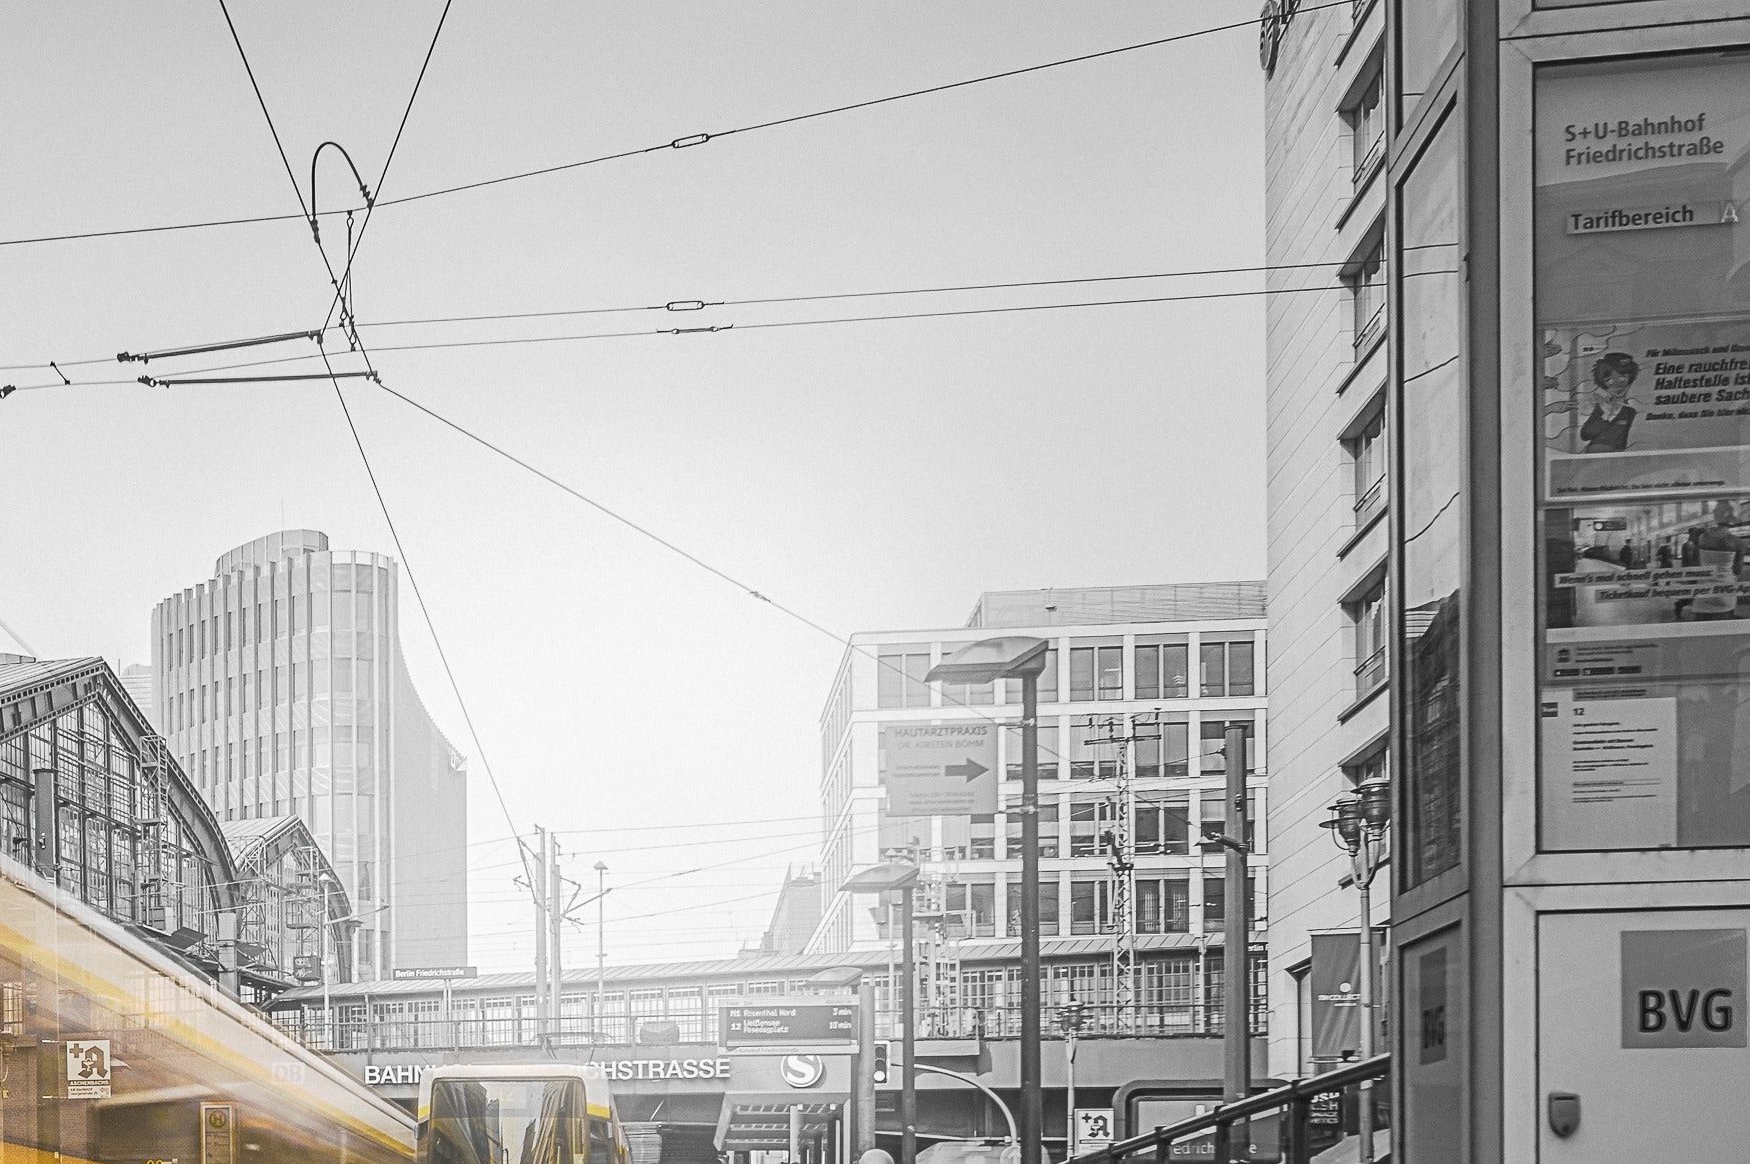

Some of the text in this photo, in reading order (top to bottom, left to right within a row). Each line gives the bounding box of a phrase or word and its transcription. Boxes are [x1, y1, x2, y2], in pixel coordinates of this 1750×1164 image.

[1564, 112, 1706, 143] S+U-Bahnhof
[1564, 136, 1725, 167] Friedrichstraße
[1571, 202, 1739, 231] Tarifbereich A
[1653, 362, 1685, 376] Eine
[1654, 374, 1730, 391] Haltestelle
[1654, 391, 1712, 406] saubere
[1559, 574, 1593, 584] Wenn's
[1595, 573, 1615, 582] mal
[1615, 570, 1651, 582] schnell
[1652, 570, 1683, 582] gehen
[1600, 588, 1651, 600] Ticketkauf
[1651, 588, 1692, 600] bequem
[1692, 588, 1711, 599] per
[1572, 707, 1585, 716] 12
[894, 726, 988, 738] HAUTARZTPRAXIS
[914, 740, 953, 750] KIRSTEN
[395, 968, 465, 978] Berlin Friedrichstraße
[730, 1007, 853, 1017] M1 Rosenthal Nord 3 min
[1638, 988, 1734, 1034] BVG
[730, 1022, 741, 1031] 12
[829, 1021, 838, 1030] 10
[838, 1021, 852, 1029] min
[1422, 1005, 1445, 1050] BVG
[585, 1058, 731, 1081] CHSTRASSE
